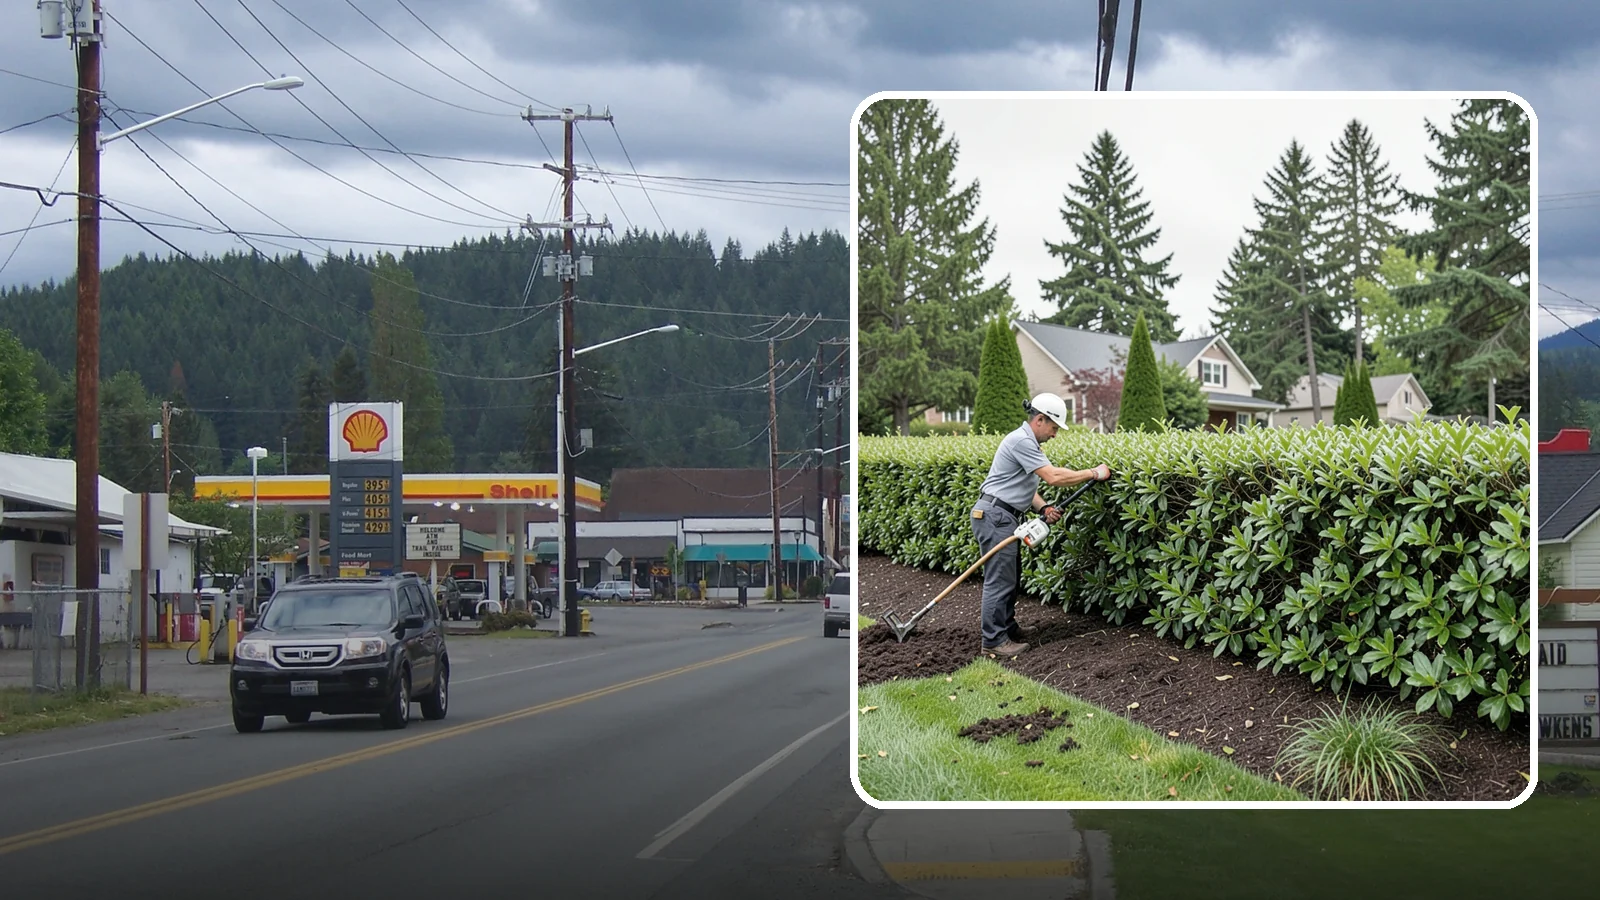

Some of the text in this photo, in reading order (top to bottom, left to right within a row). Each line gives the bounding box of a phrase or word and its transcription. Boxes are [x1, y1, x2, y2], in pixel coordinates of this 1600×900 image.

[366, 480, 384, 490] 395
[490, 484, 547, 499] Shell
[366, 494, 384, 504] 405
[366, 508, 384, 518] 415
[366, 522, 384, 532] 429
